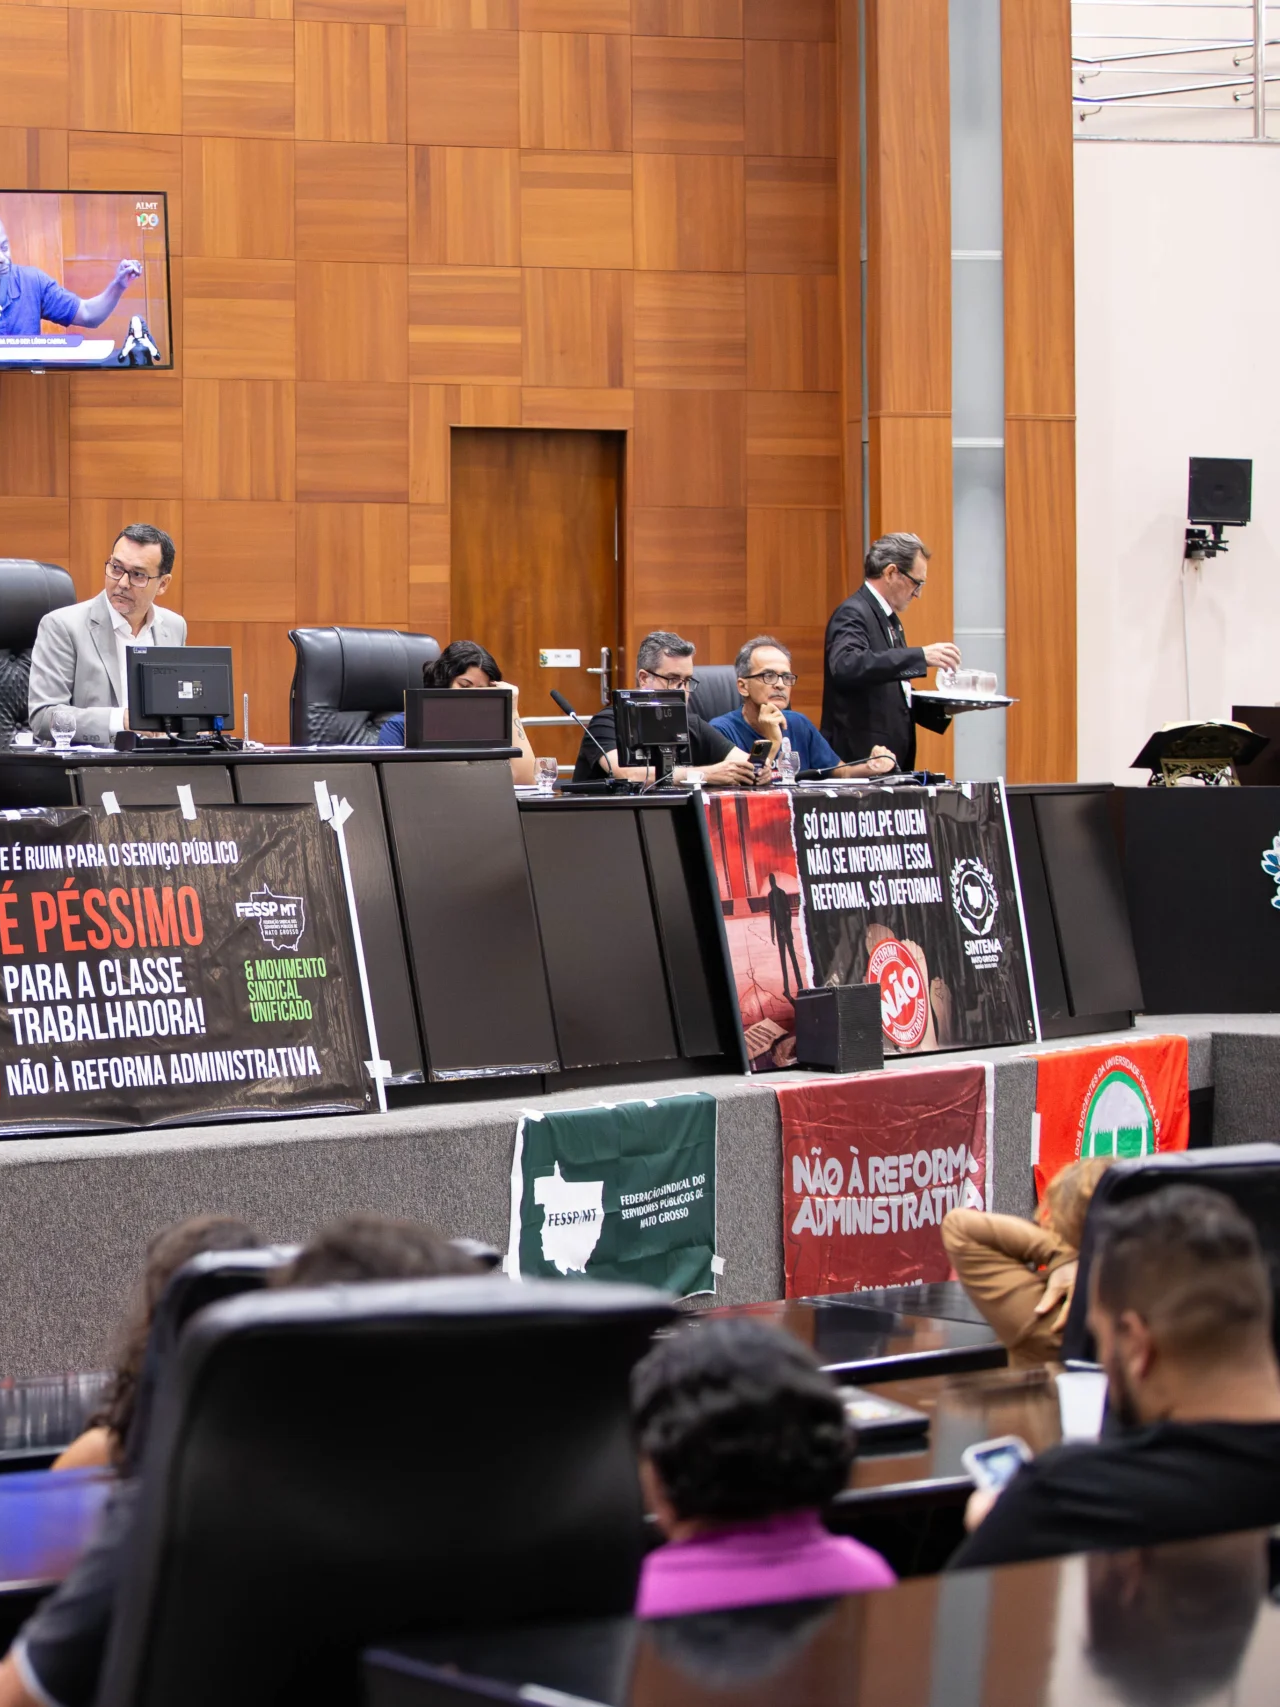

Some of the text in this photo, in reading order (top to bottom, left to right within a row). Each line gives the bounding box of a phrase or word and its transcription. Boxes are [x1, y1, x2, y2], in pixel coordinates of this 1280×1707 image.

[663, 708, 672, 718] LG
[803, 808, 927, 840] SÓ CAI NO GOLPE QUEM
[12, 840, 22, 871] É
[26, 843, 63, 870] RUIM
[67, 841, 107, 869] PARA
[109, 841, 120, 867] O
[122, 840, 180, 871] SERVIÇO
[182, 837, 239, 866] PÚBLICO
[806, 843, 933, 875] NÃO SE INFORMA! ESSA
[811, 875, 942, 910] REFORMA, SÓ DEFORMA!
[31, 878, 203, 953] PÉSSIMO
[235, 901, 297, 917] FESSP MT
[245, 957, 327, 979] & MOVIMENTO
[871, 944, 898, 976] REFORMA
[3, 957, 186, 1003] PARA A CLASSE
[247, 979, 303, 1002] SINDICAL
[251, 1000, 313, 1023] UNIFICADO
[881, 967, 920, 1028] NÃO
[8, 998, 207, 1046] TRABALHADORA!
[5, 1046, 321, 1096] NÃO À REFORMA ADMINISTRATIVA
[1078, 1073, 1098, 1128] DOCENTES
[1097, 1064, 1106, 1078] DA
[1105, 1055, 1141, 1077] UNIVERSIDADE
[692, 1173, 706, 1188] DOS
[792, 1143, 979, 1195] NÃO À REFORMA
[548, 1208, 597, 1227] FESSP/MT
[621, 1188, 704, 1220] SERVIDORES PÚBLICOS DE
[639, 1207, 689, 1230] MATO GROSSO
[791, 1177, 984, 1237] ADMINISTRATIVA
